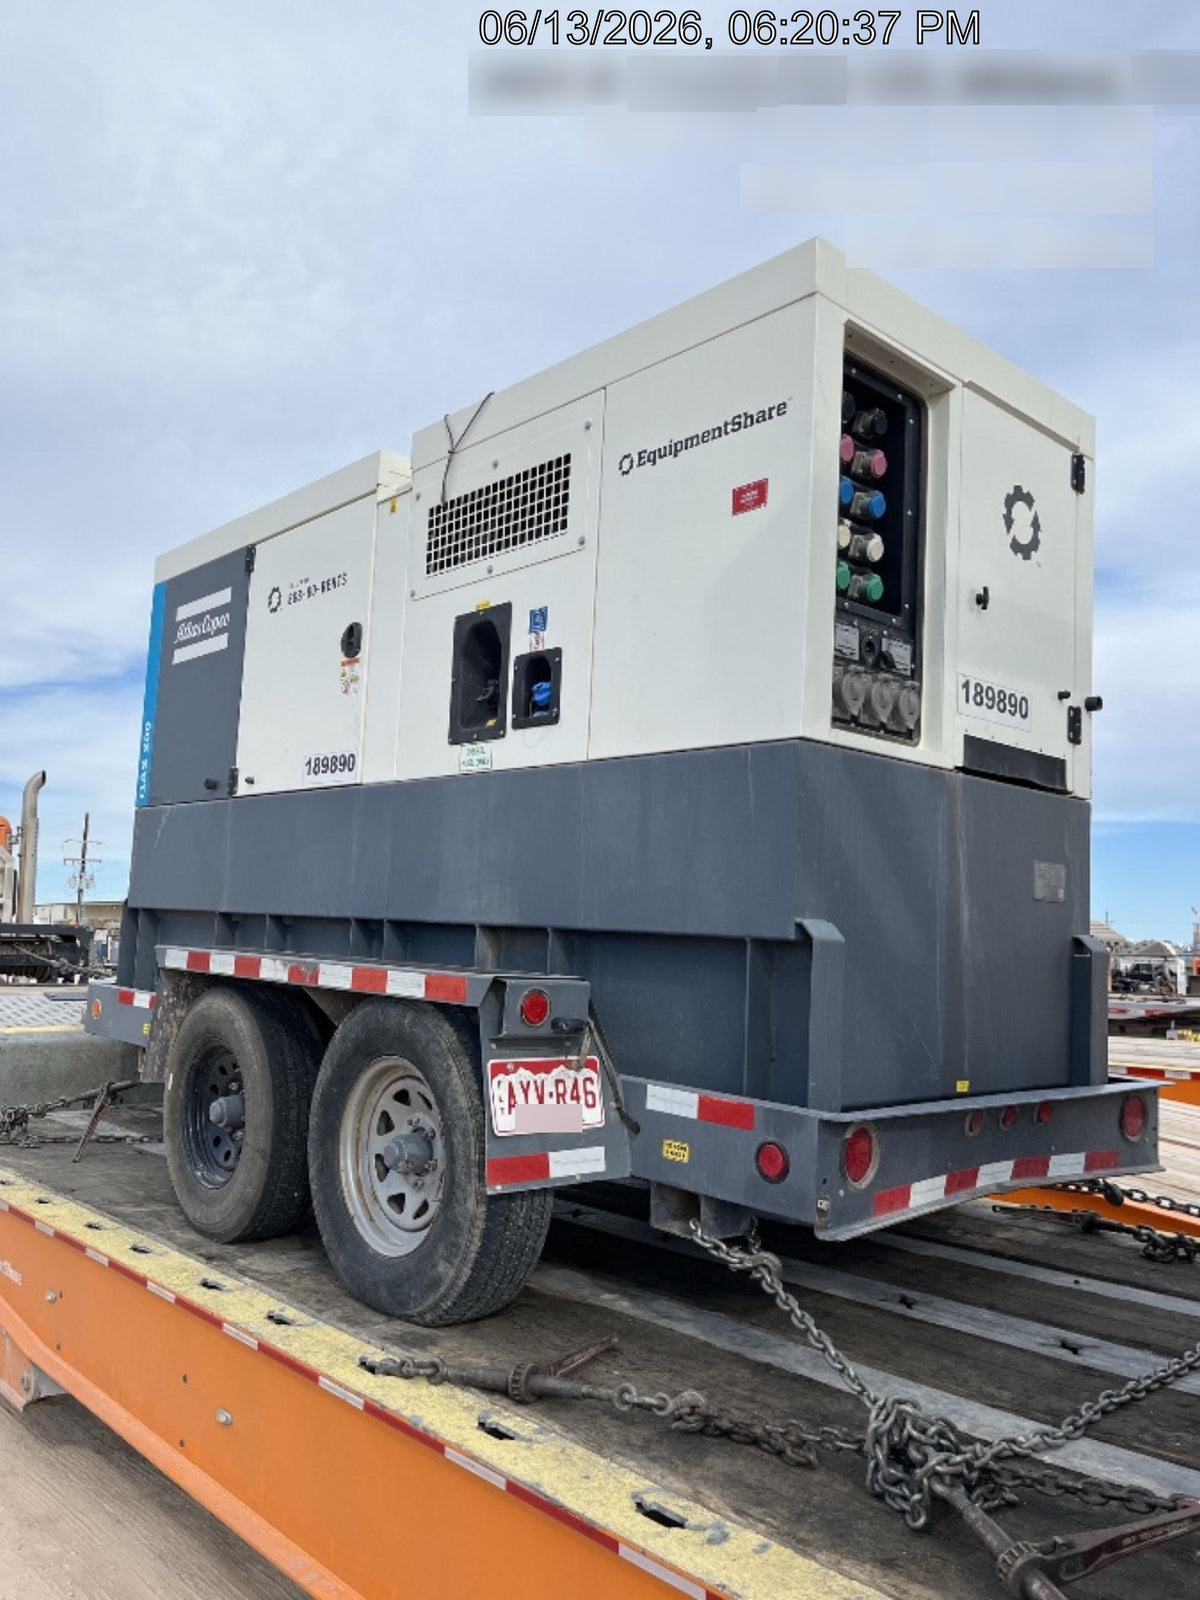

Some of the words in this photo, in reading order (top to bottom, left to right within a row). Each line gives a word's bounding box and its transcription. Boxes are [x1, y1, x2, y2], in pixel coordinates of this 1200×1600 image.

[636, 400, 788, 468] EquipmentShare
[173, 621, 202, 645] Atlas
[202, 613, 230, 635] Copco
[961, 679, 1029, 720] 189890
[305, 753, 356, 776] 189890
